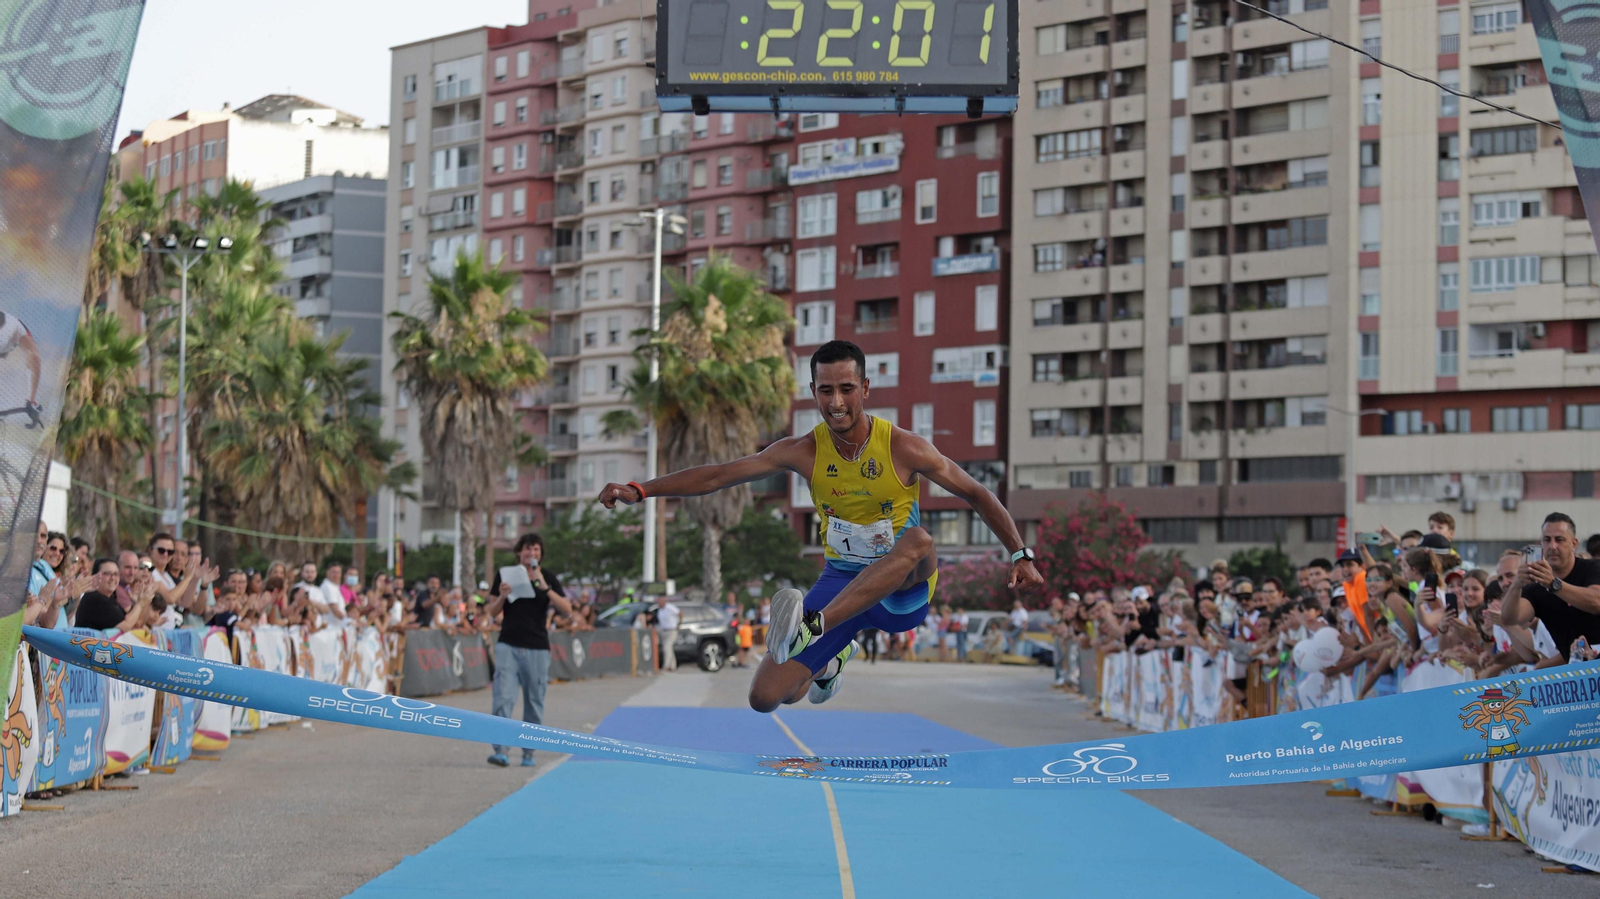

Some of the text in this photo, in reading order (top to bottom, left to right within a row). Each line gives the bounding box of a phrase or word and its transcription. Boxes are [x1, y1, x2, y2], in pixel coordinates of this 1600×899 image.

[832, 71, 853, 82] 615
[856, 71, 876, 82] 980
[879, 71, 899, 82] 784
[842, 538, 850, 551] 1
[149, 650, 175, 658] PUERTO
[206, 660, 243, 670] ALGECIRAS
[167, 674, 200, 685] Algeciras
[1530, 678, 1588, 708] CARRERA
[308, 696, 462, 728] SPECIAL BIKES
[1543, 706, 1569, 715] PUERTO
[1570, 703, 1590, 711] BAHÍA
[521, 723, 566, 735] Puerto
[518, 733, 560, 744] Autoridad
[561, 740, 598, 750] Portuaria
[658, 755, 696, 765] Algeciras
[1226, 736, 1403, 763] Puerto Bahía de Algeciras
[831, 758, 948, 769] CARRERA POPULAR
[1229, 769, 1270, 779] Autoridad
[1272, 766, 1309, 776] Portuaria
[1333, 761, 1355, 770] Bahía
[1369, 757, 1406, 768] Algeciras
[1107, 774, 1169, 783] BIKES
